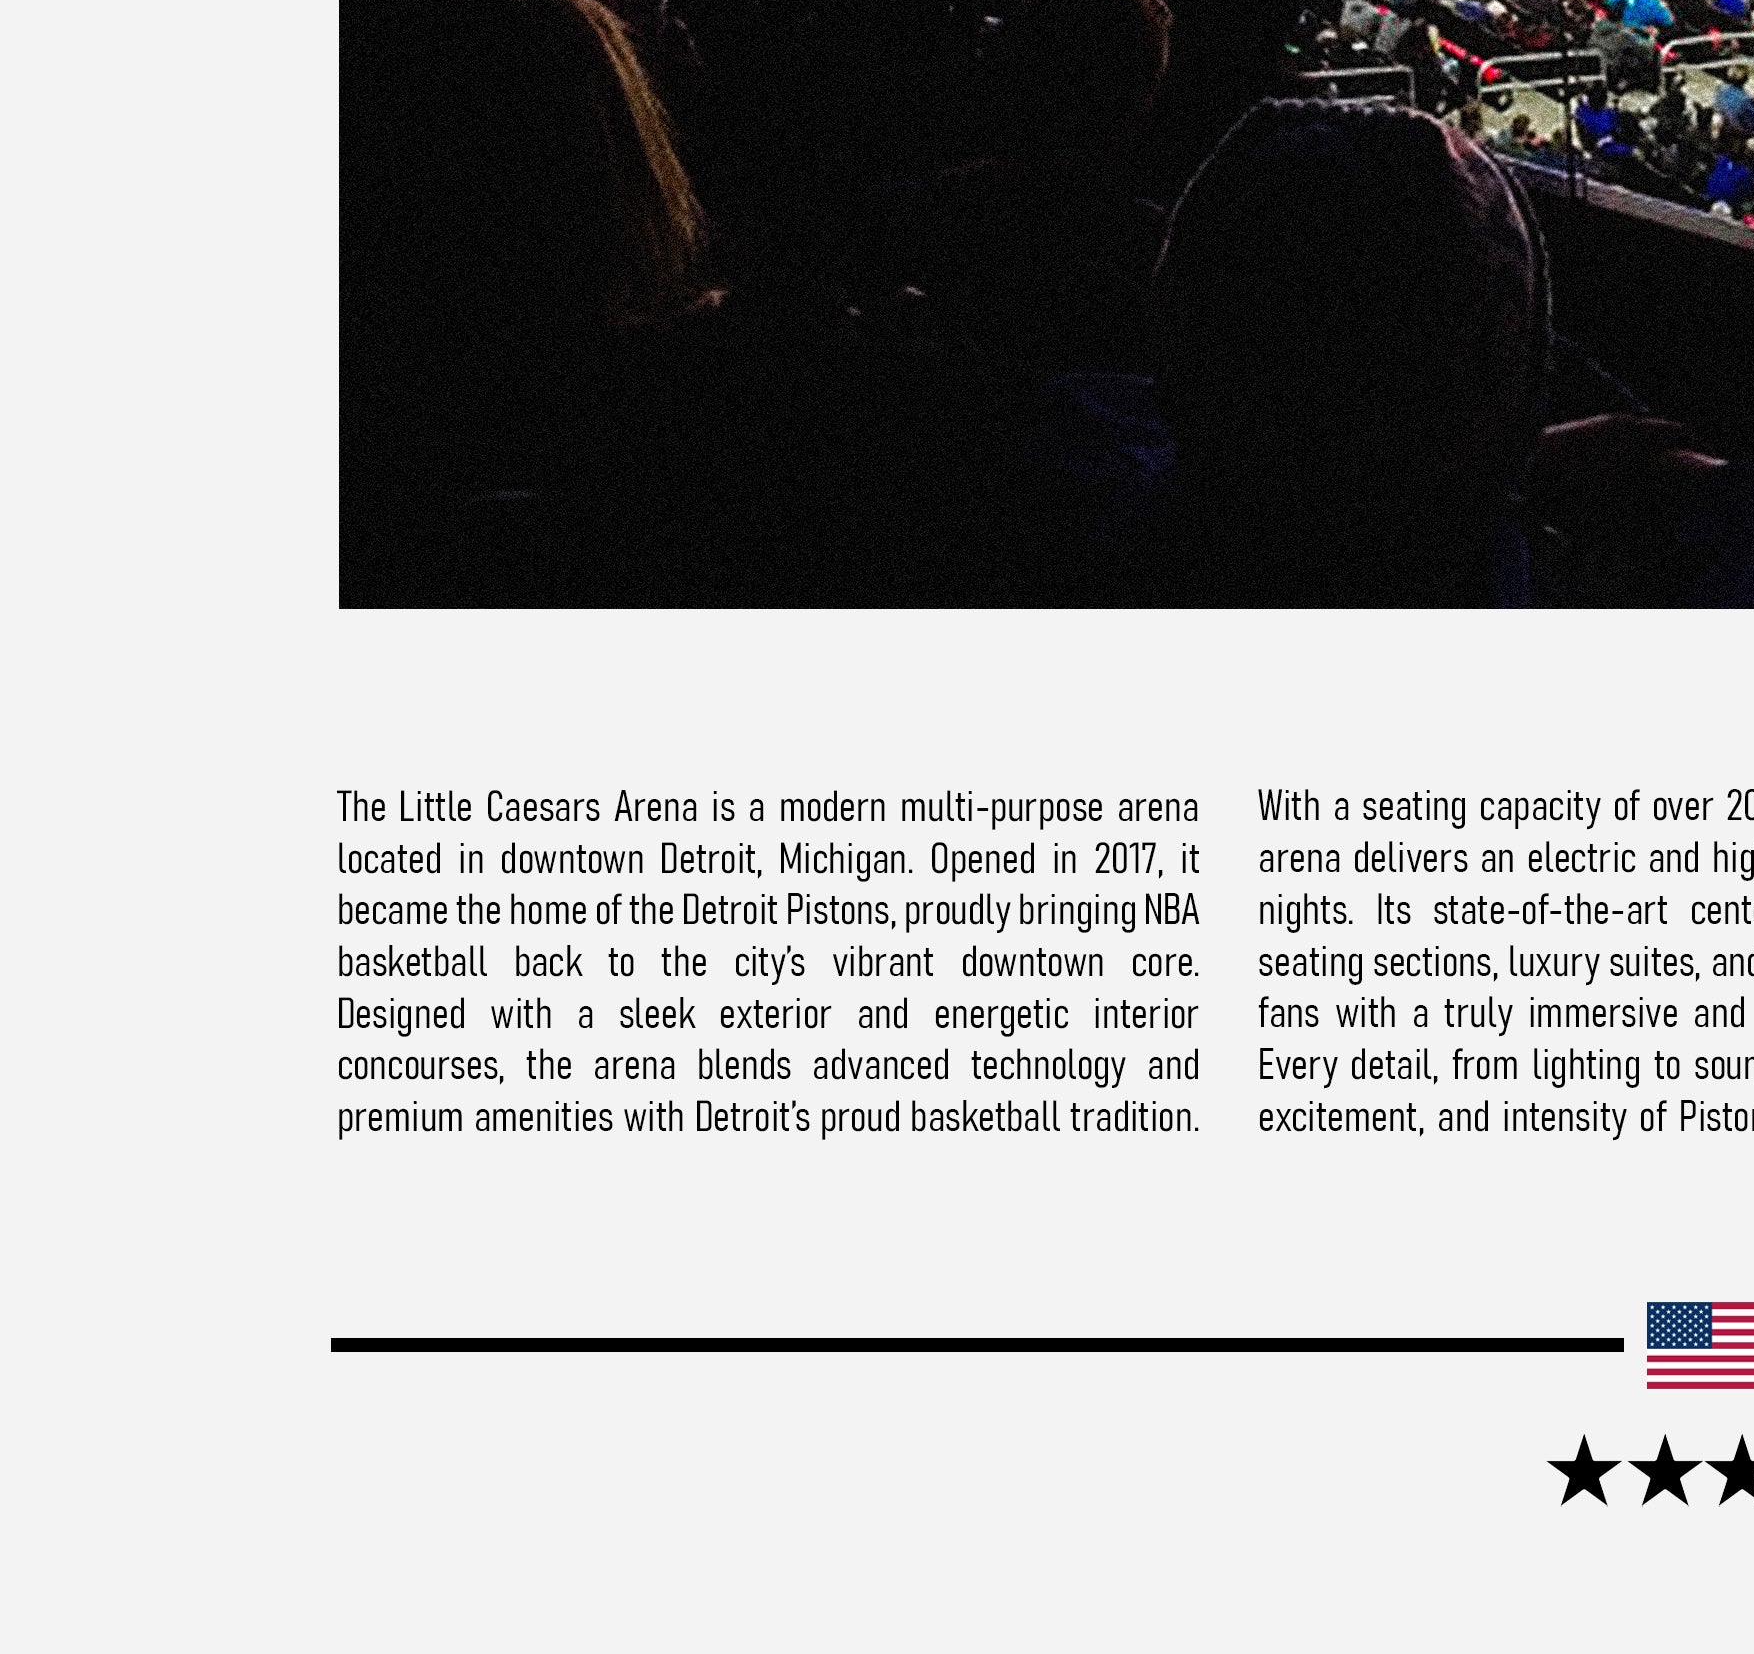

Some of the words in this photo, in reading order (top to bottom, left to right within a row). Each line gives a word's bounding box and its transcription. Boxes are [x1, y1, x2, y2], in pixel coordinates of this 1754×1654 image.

[337, 790, 385, 821] The
[401, 790, 471, 821] Little
[488, 790, 600, 821] Caesars
[615, 790, 696, 821] Arena
[714, 791, 735, 821] is
[750, 799, 763, 821] a
[781, 790, 885, 821] modern
[902, 790, 1102, 830] multi-purpose
[1119, 799, 1197, 821] arena
[1258, 789, 1319, 820] With
[1335, 798, 1348, 820] a
[1363, 790, 1465, 829] seating
[1481, 790, 1601, 829] capacity
[1615, 789, 1640, 820] of
[1654, 798, 1713, 820] over
[339, 842, 440, 873] located
[461, 843, 483, 873] in
[502, 842, 643, 873] downtown
[662, 842, 762, 878] Detroit,
[781, 842, 912, 882] Michigan.
[932, 842, 1034, 882] Opened
[1055, 843, 1076, 873] in
[1096, 842, 1163, 878] 2017,
[1183, 843, 1199, 873] it
[339, 893, 447, 924] became
[456, 893, 500, 924] the
[511, 893, 586, 924] home
[597, 893, 622, 924] of
[629, 893, 673, 924] the
[684, 893, 777, 924] Detroit
[788, 893, 896, 930] Pistons,
[906, 893, 1010, 933] proudly
[1020, 893, 1135, 933] bringing
[1146, 893, 1199, 924] NBA
[1260, 893, 1353, 933] nights.
[1378, 893, 1411, 924] Its
[1434, 893, 1667, 924] state-of-the-art
[1259, 946, 1362, 985] seating
[1374, 946, 1497, 981] sections,
[1510, 945, 1600, 985] luxury
[1610, 946, 1700, 981] suites,
[339, 997, 464, 1037] Designed
[491, 997, 551, 1028] with
[579, 1006, 592, 1028] a
[620, 997, 696, 1028] sleek
[721, 998, 831, 1028] exterior
[859, 997, 907, 1029] and
[936, 998, 1068, 1037] energetic
[1096, 998, 1198, 1028] interior
[1259, 996, 1319, 1027] fans
[1336, 996, 1395, 1027] with
[1414, 1005, 1427, 1027] a
[1445, 996, 1513, 1036] truly
[1531, 997, 1677, 1027] immersive
[1695, 996, 1744, 1027] and
[1260, 1101, 1424, 1137] excitement,
[1439, 1100, 1488, 1131] and
[1505, 1101, 1627, 1140] intensity
[1641, 1100, 1667, 1131] of
